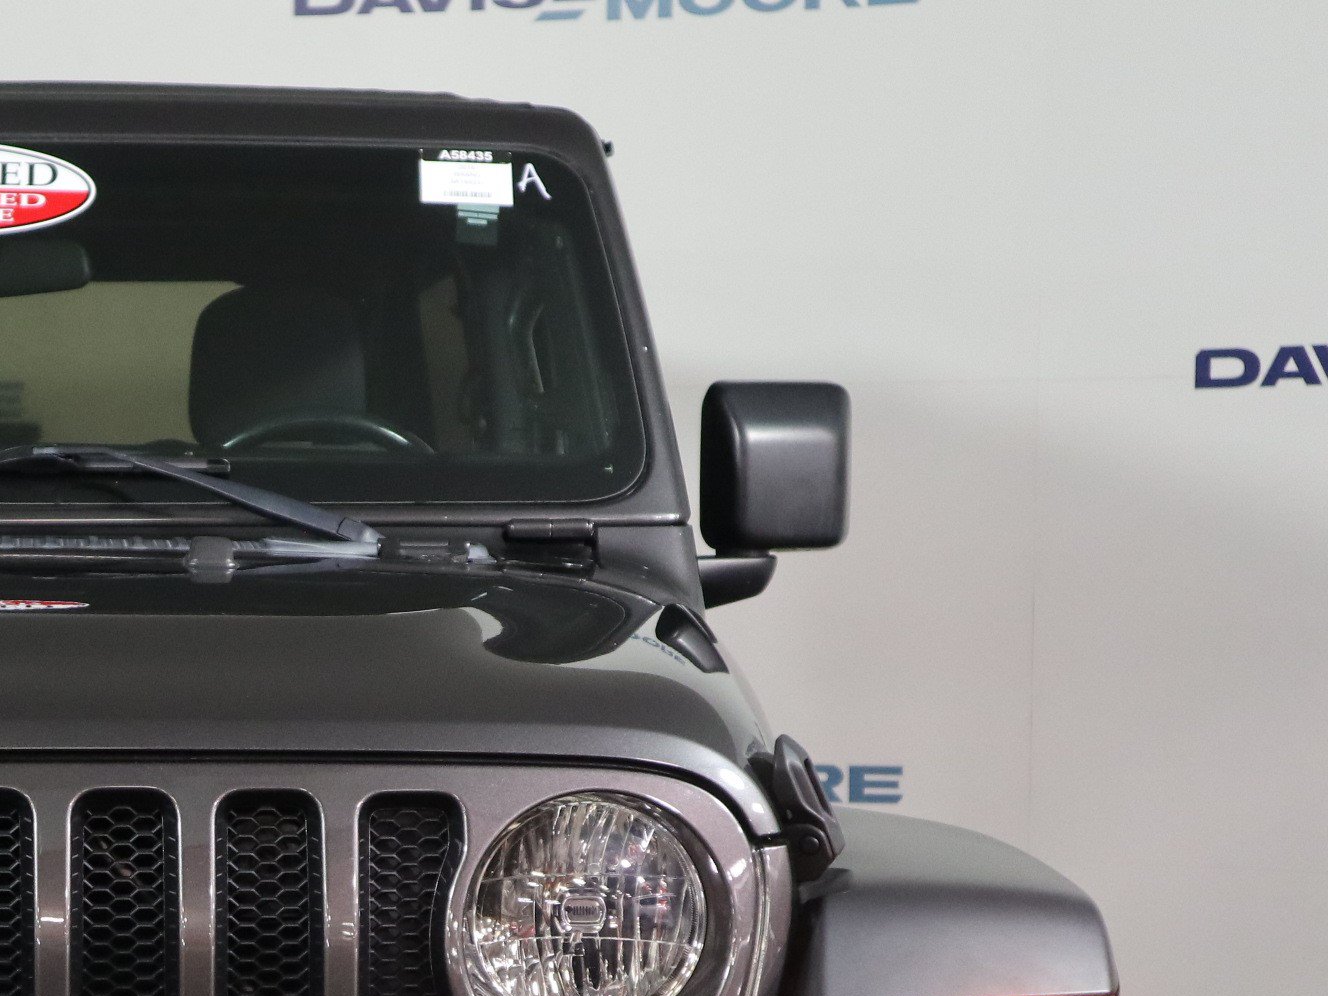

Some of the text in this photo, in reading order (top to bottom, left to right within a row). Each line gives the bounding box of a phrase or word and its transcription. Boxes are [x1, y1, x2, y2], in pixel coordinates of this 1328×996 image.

[438, 149, 493, 162] A58435
[517, 163, 552, 200] A
[1195, 345, 1328, 388] DA
